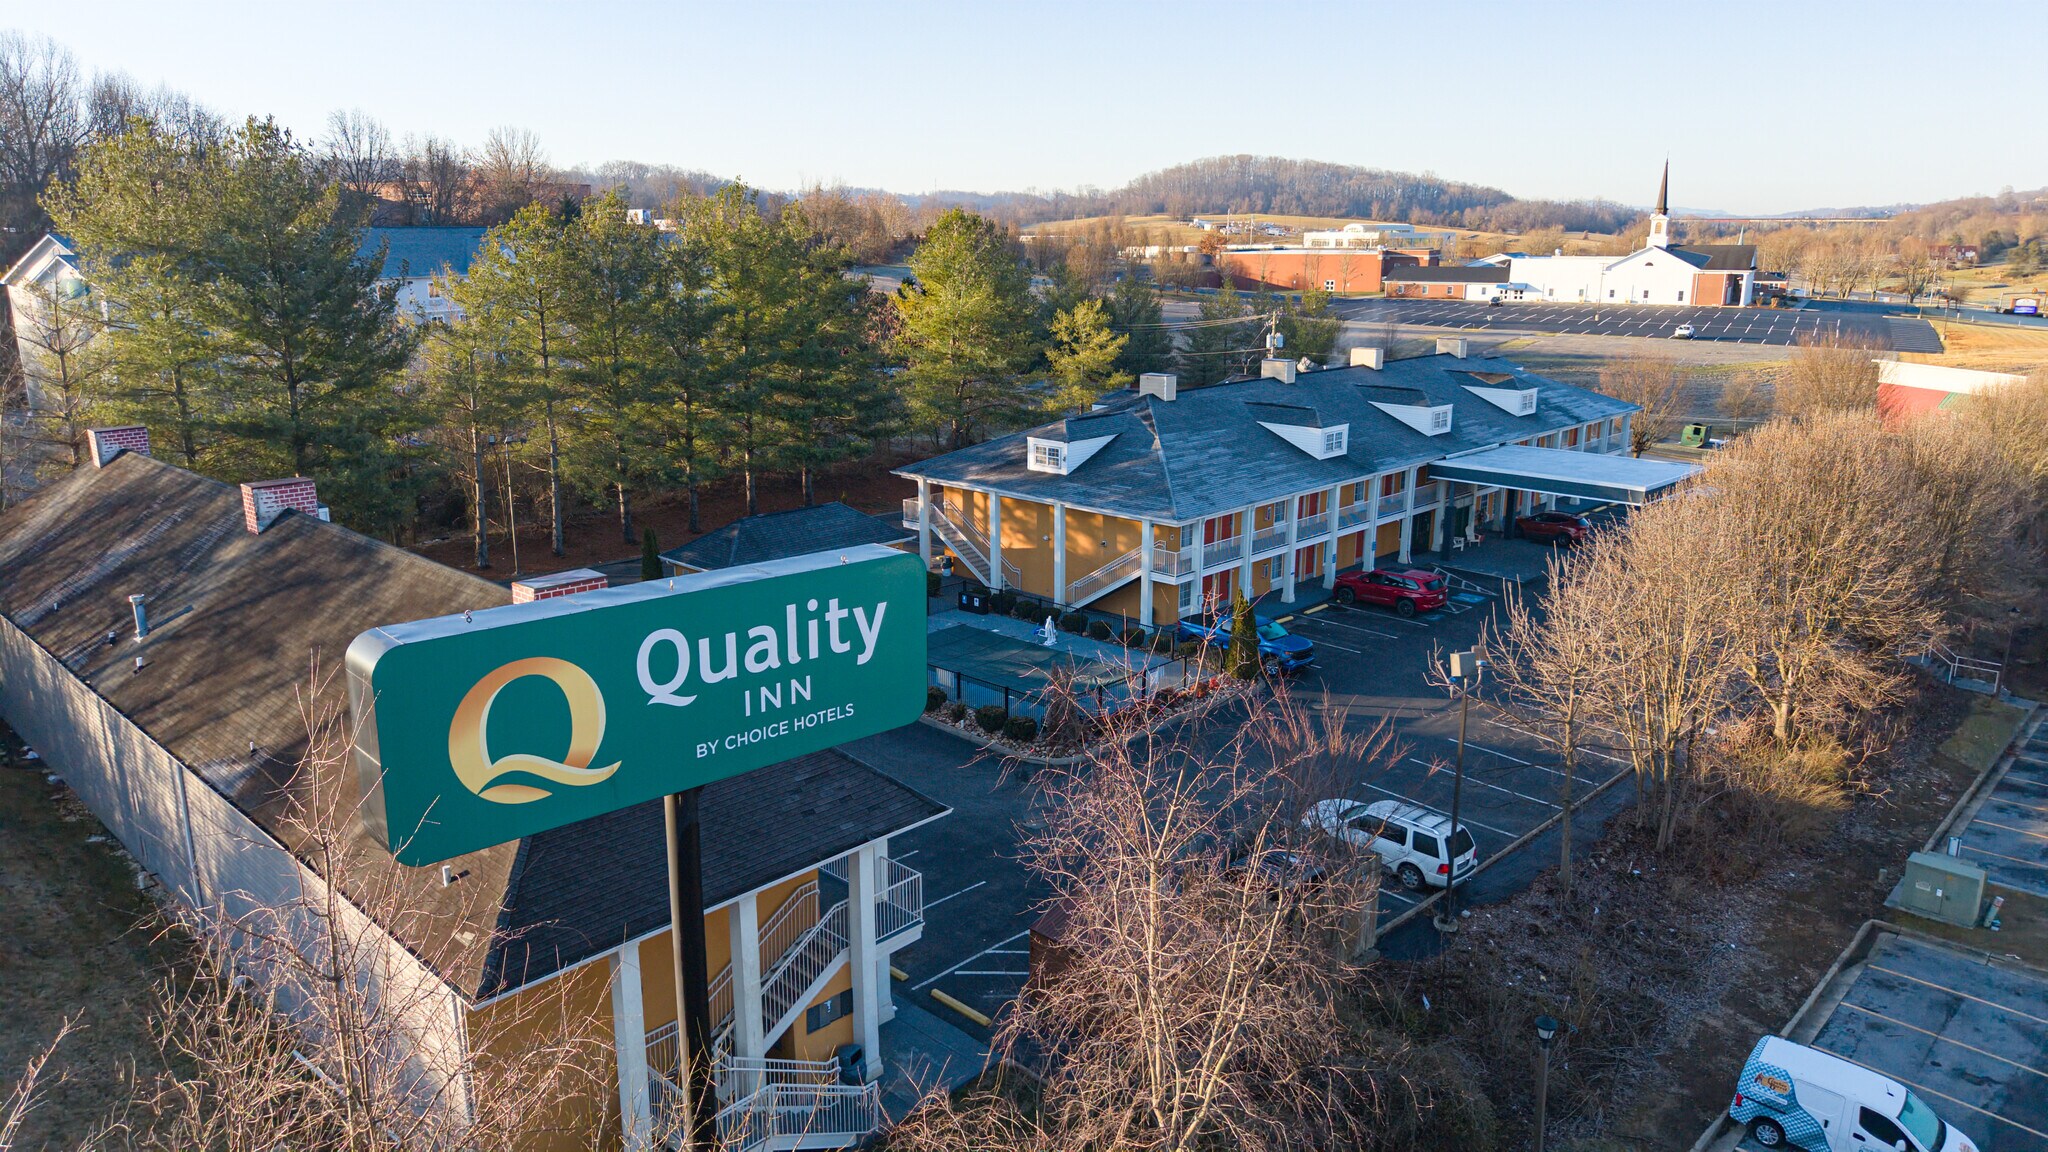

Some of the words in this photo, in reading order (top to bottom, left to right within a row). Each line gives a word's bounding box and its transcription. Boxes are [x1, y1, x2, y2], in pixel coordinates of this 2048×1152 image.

[636, 598, 888, 707] Quality
[449, 656, 623, 805] Q
[696, 739, 719, 758] BY
[724, 720, 789, 750] CHOICE
[794, 703, 855, 731] HOTELS
[744, 675, 811, 717] INN
